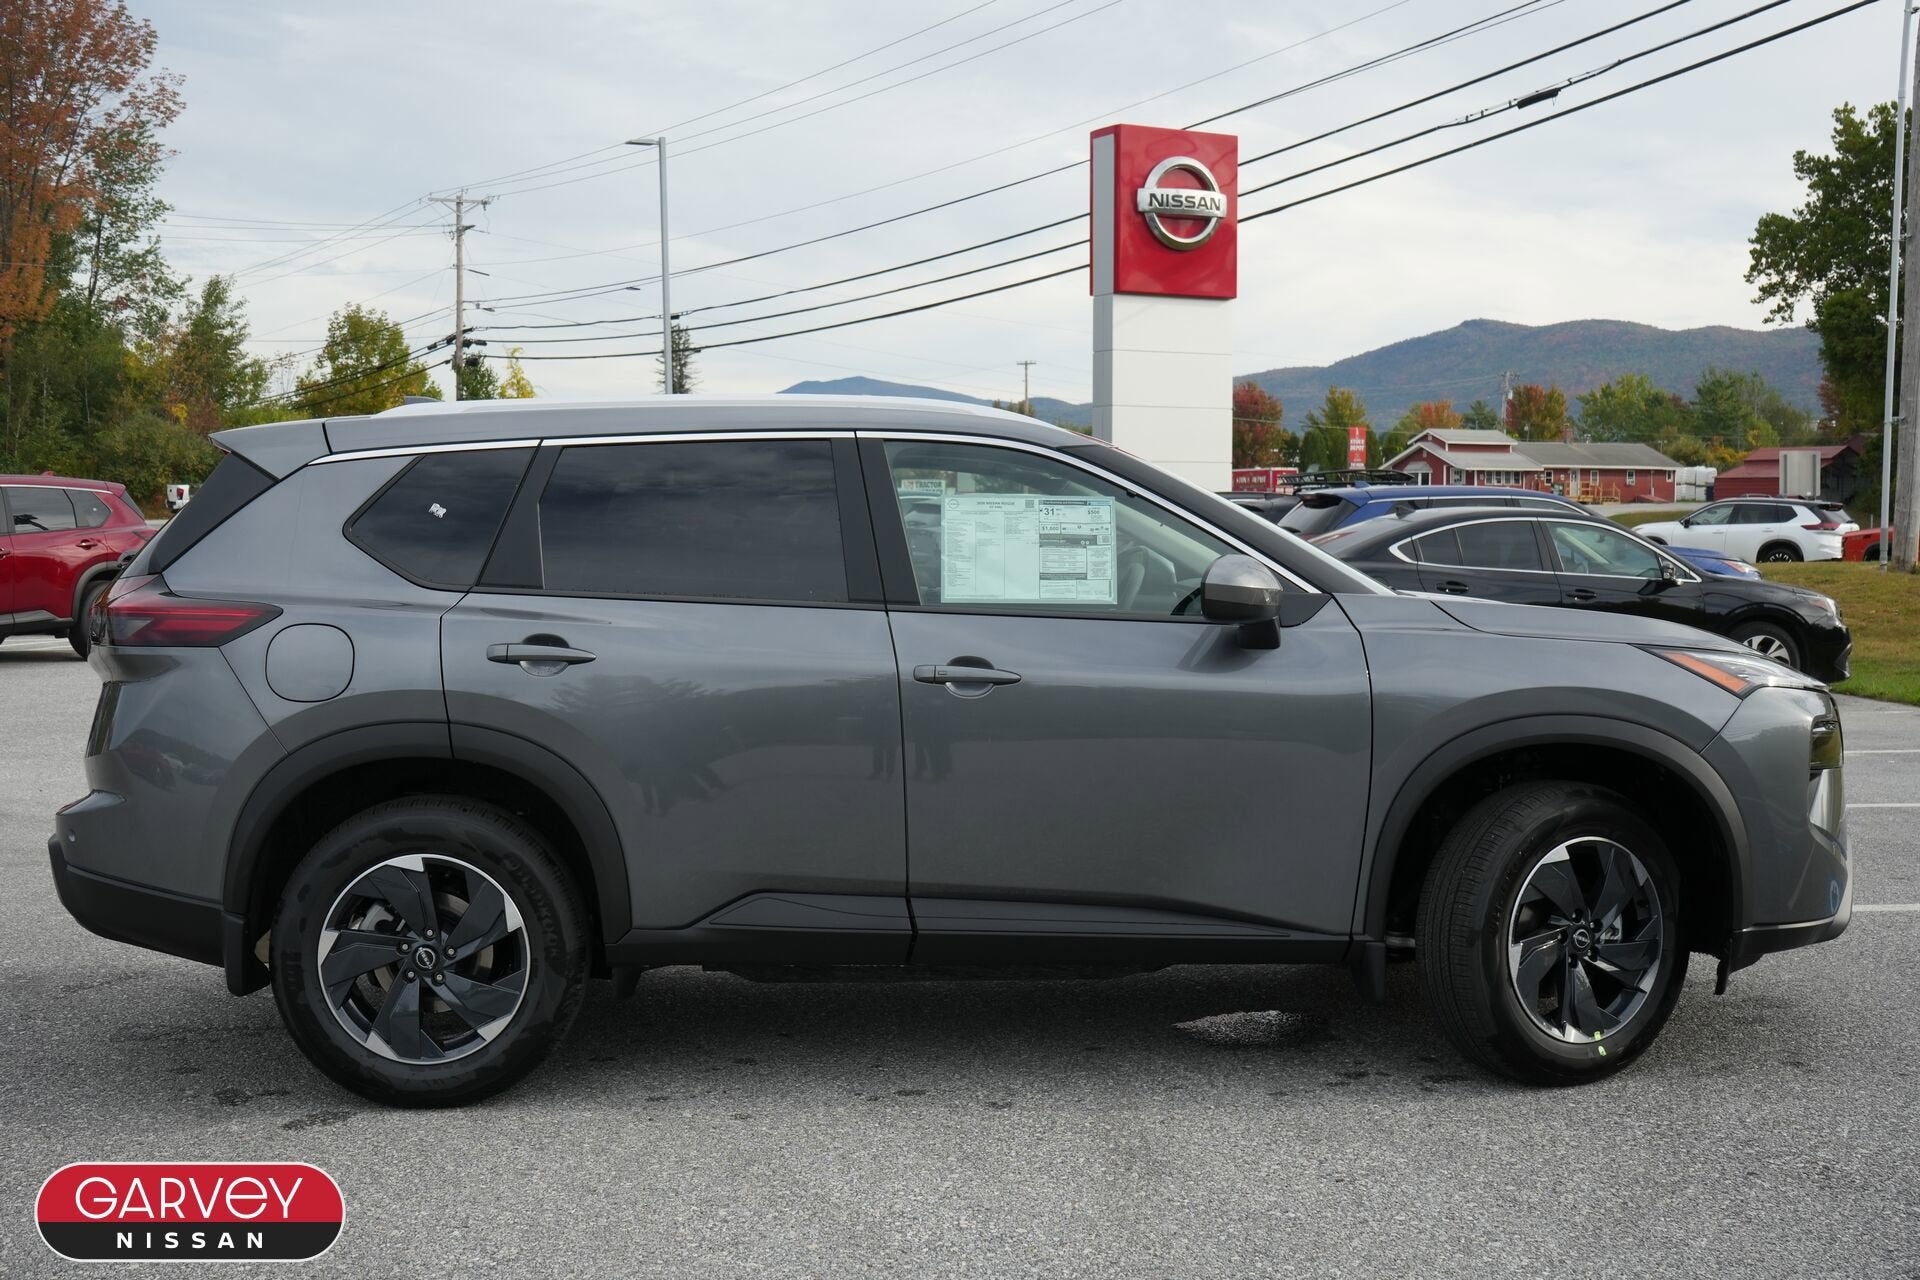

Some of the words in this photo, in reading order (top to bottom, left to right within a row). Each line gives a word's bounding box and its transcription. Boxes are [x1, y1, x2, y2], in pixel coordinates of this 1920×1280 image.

[1148, 192, 1221, 211] NISSAN
[915, 481, 942, 489] TRACTOR
[1044, 507, 1055, 516] 31
